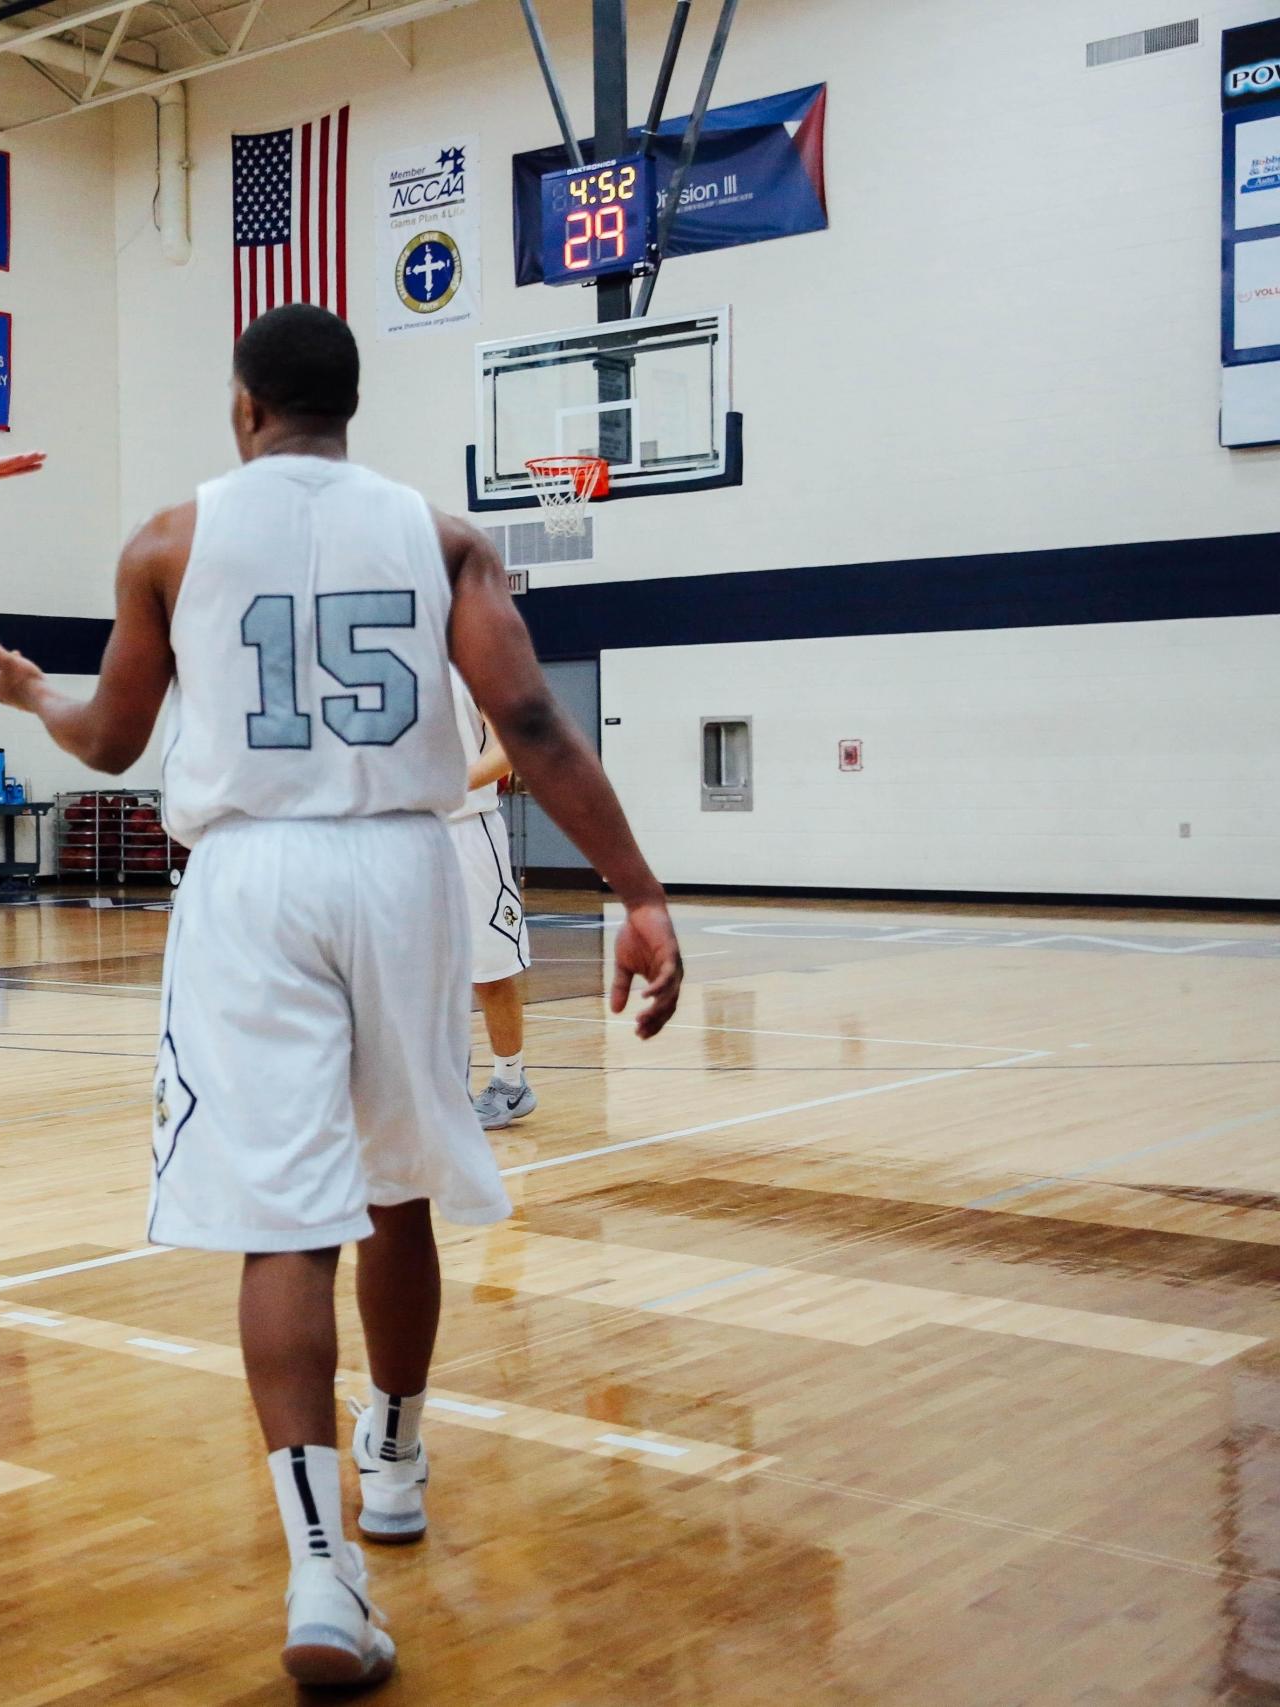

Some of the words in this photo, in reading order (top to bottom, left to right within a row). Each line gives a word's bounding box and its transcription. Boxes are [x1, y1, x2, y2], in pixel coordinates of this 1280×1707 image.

[389, 167, 426, 180] Member
[567, 159, 617, 175] DAKTRONICS
[392, 175, 464, 209] NCCAA
[570, 166, 636, 205] 4:52
[723, 174, 737, 196] III
[390, 218, 416, 229] Game
[564, 205, 625, 269] 29
[507, 574, 521, 591] XIT
[240, 590, 418, 750] 15
